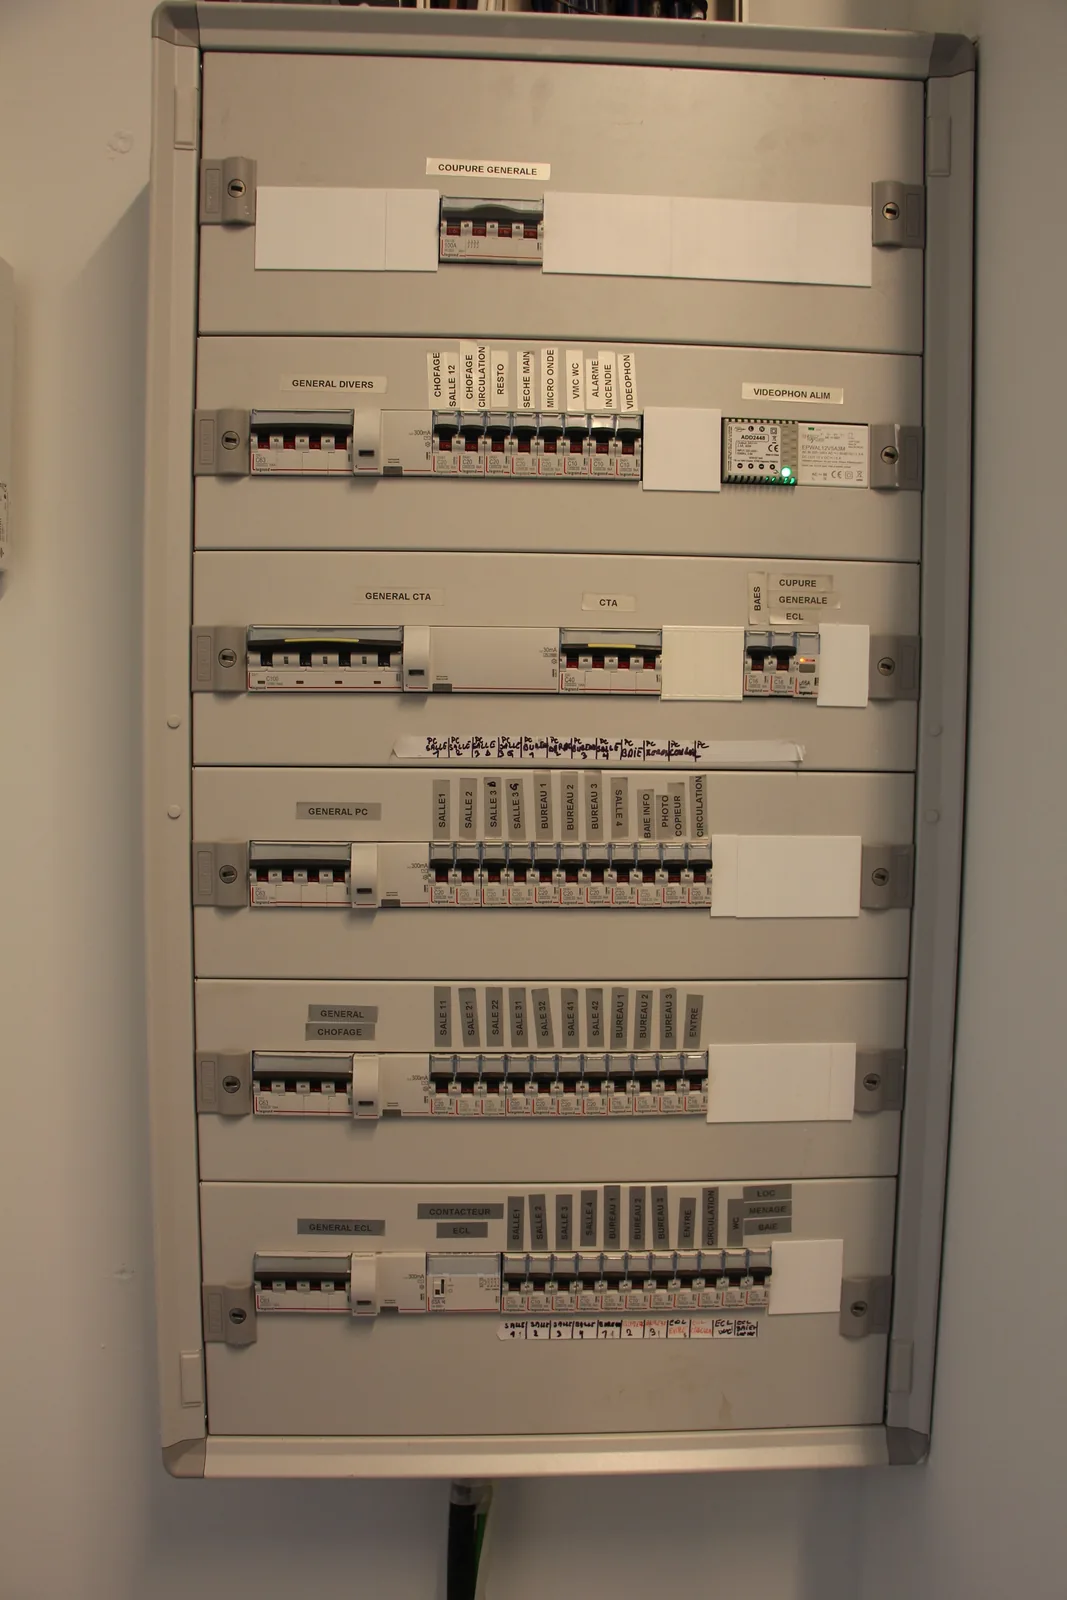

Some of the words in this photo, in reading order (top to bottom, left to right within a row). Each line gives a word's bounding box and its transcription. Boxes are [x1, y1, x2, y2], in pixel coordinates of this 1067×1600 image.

[438, 164, 484, 173] COUPURE
[487, 166, 537, 175] GENERALE
[522, 352, 530, 374] MAIN
[546, 350, 554, 376] ONDE
[432, 352, 442, 398] CHOFAGE
[448, 364, 456, 376] 12
[572, 362, 580, 378] WC
[466, 354, 474, 400] CHOFAGE
[496, 364, 504, 394] RESTO
[624, 354, 634, 410] VIDEOPHON
[292, 380, 336, 388] GENERAL
[339, 380, 374, 388] DIVERS
[604, 364, 612, 408] INCENDIE
[546, 378, 554, 408] MICRO
[754, 388, 807, 398] VIDEOPHON
[810, 391, 830, 400] ALIM
[779, 579, 816, 588] CUPURE
[365, 592, 410, 600] GENERAL
[412, 592, 431, 600] CTA
[754, 586, 762, 611] BAES
[779, 596, 828, 604] GENERALE
[786, 612, 804, 620] ECL
[308, 808, 352, 816] GENERAL
[540, 790, 548, 829] BUREAU
[590, 790, 599, 829] BUREAU
[695, 776, 704, 837] CIRCULATION
[513, 798, 521, 829] SALLE
[674, 796, 682, 836] COPIEUR
[440, 1000, 446, 1010] 11
[466, 1001, 472, 1010] 21
[492, 1000, 498, 1010] 22
[515, 1001, 522, 1010] 31
[538, 1001, 546, 1011] 32
[567, 1001, 574, 1010] 41
[592, 1000, 598, 1010] 42
[320, 1010, 364, 1018] GENERAL
[616, 1001, 624, 1038] BUREAU
[640, 1002, 648, 1038] BUREAU
[540, 1013, 548, 1036] SALE
[689, 1008, 698, 1038] ENTRE
[318, 1028, 362, 1036] CHOFAGE
[750, 1206, 787, 1214] MENAGE
[309, 1223, 351, 1232] GENERAL
[683, 1210, 692, 1237] ENTRE
[733, 1217, 739, 1230] WC
